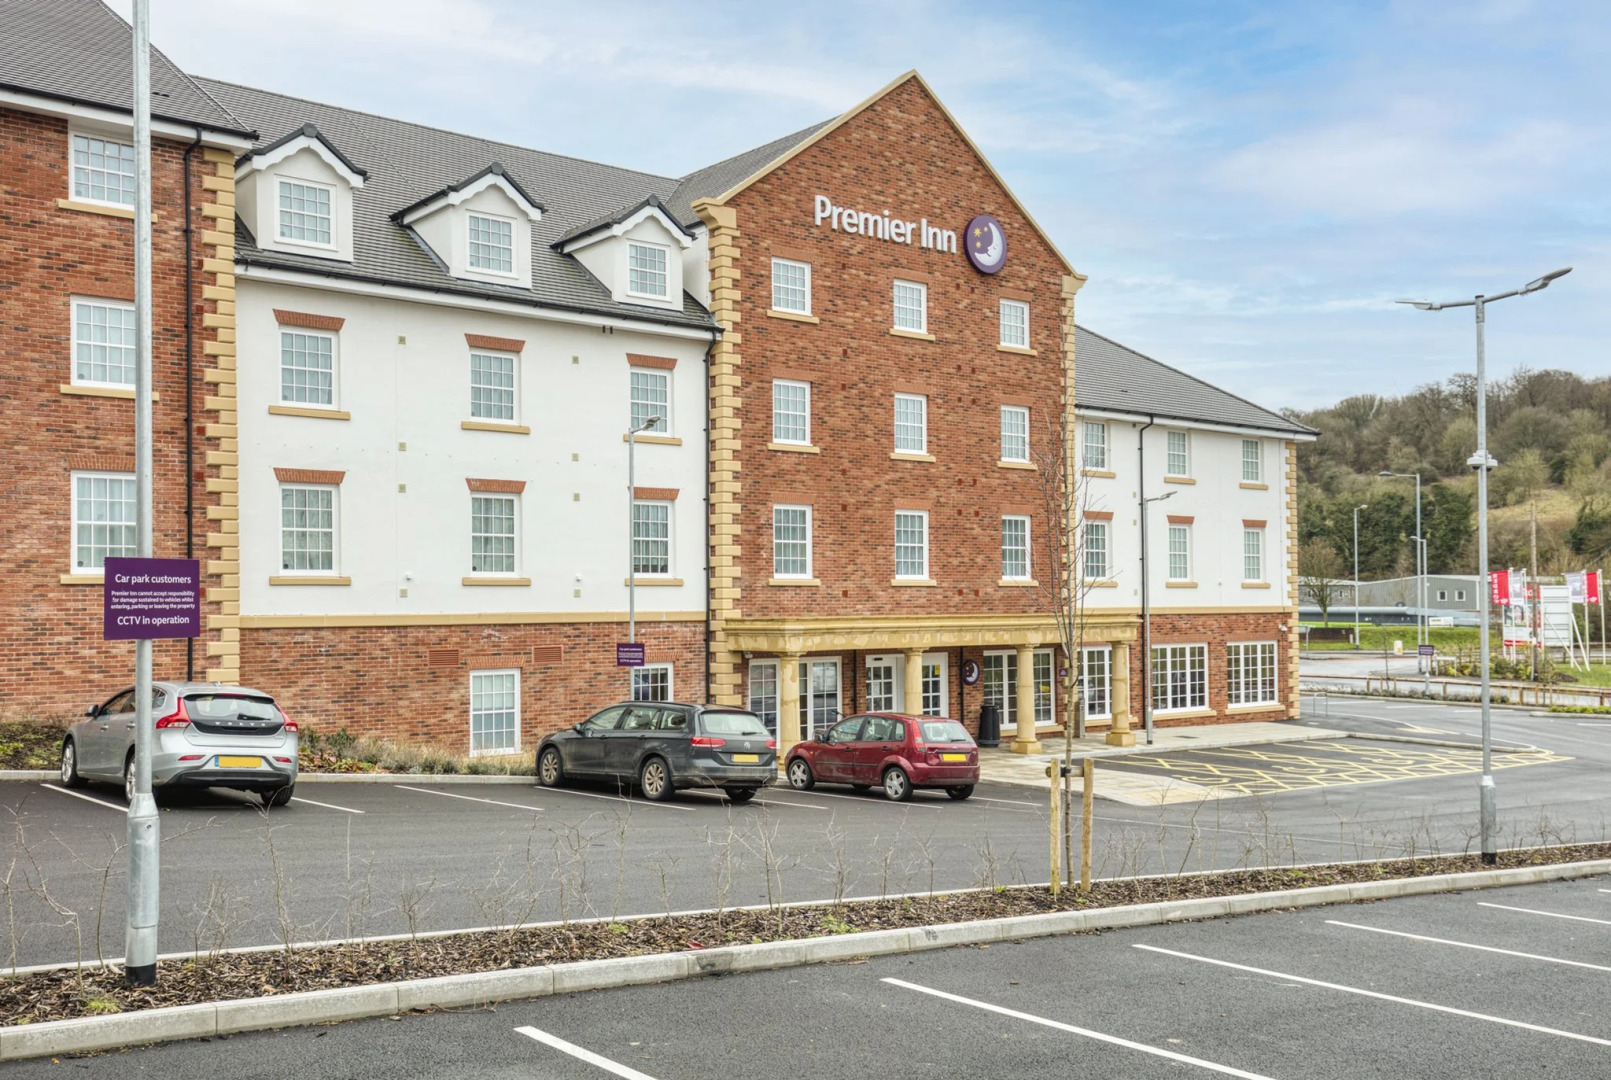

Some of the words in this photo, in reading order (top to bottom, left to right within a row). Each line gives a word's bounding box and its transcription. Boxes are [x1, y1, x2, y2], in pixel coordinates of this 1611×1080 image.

[814, 194, 916, 245] Premier
[920, 217, 957, 254] Inn
[115, 573, 130, 583] Car
[131, 574, 150, 585] park
[151, 575, 192, 584] customers
[117, 616, 141, 626] CCTV
[142, 615, 150, 625] in
[151, 615, 190, 627] operation
